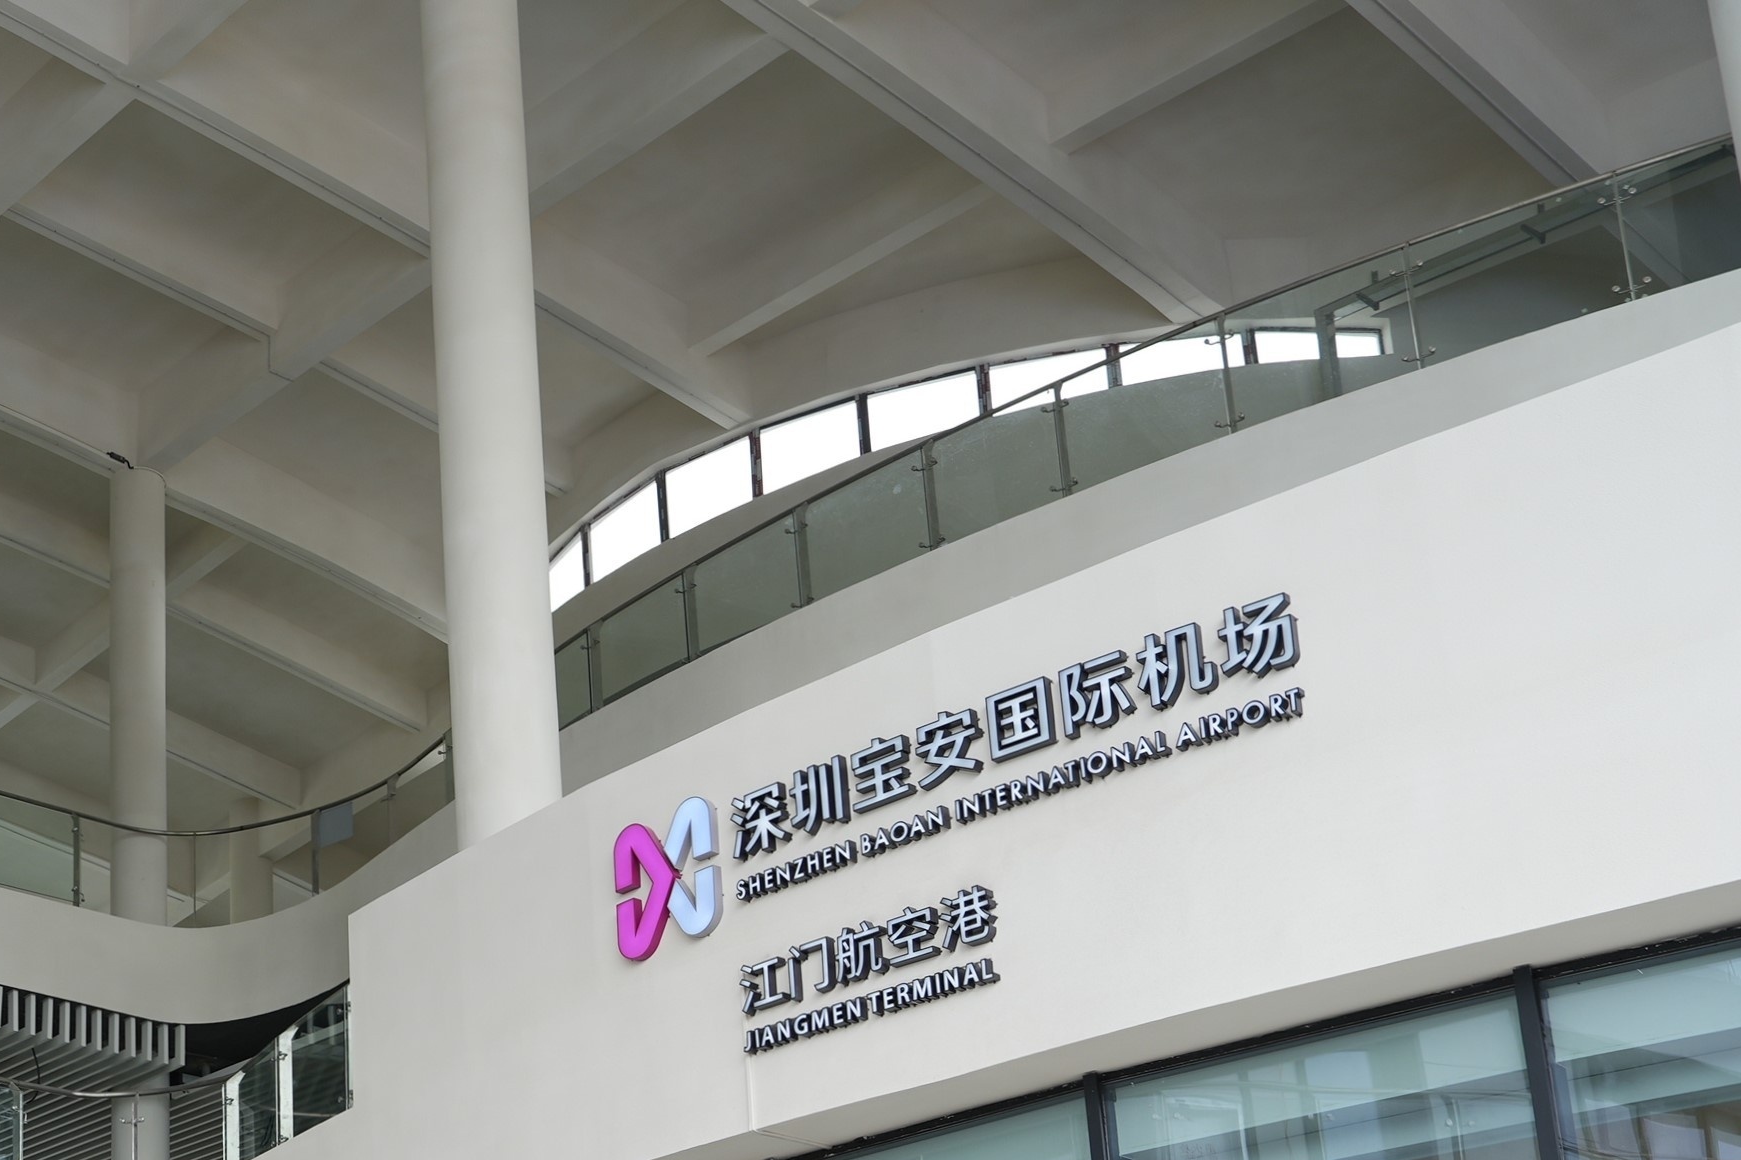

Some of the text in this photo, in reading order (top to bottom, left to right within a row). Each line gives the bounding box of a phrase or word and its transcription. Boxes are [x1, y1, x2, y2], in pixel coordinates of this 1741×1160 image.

[730, 591, 1302, 861] 深圳宝安国际机场
[735, 686, 1306, 903] SHENZHEN BAOAN INTERNATIONAL AIRPORT
[739, 884, 998, 1017] 江门航空港
[743, 957, 1001, 1056] JIANGMEN TERMINAL
